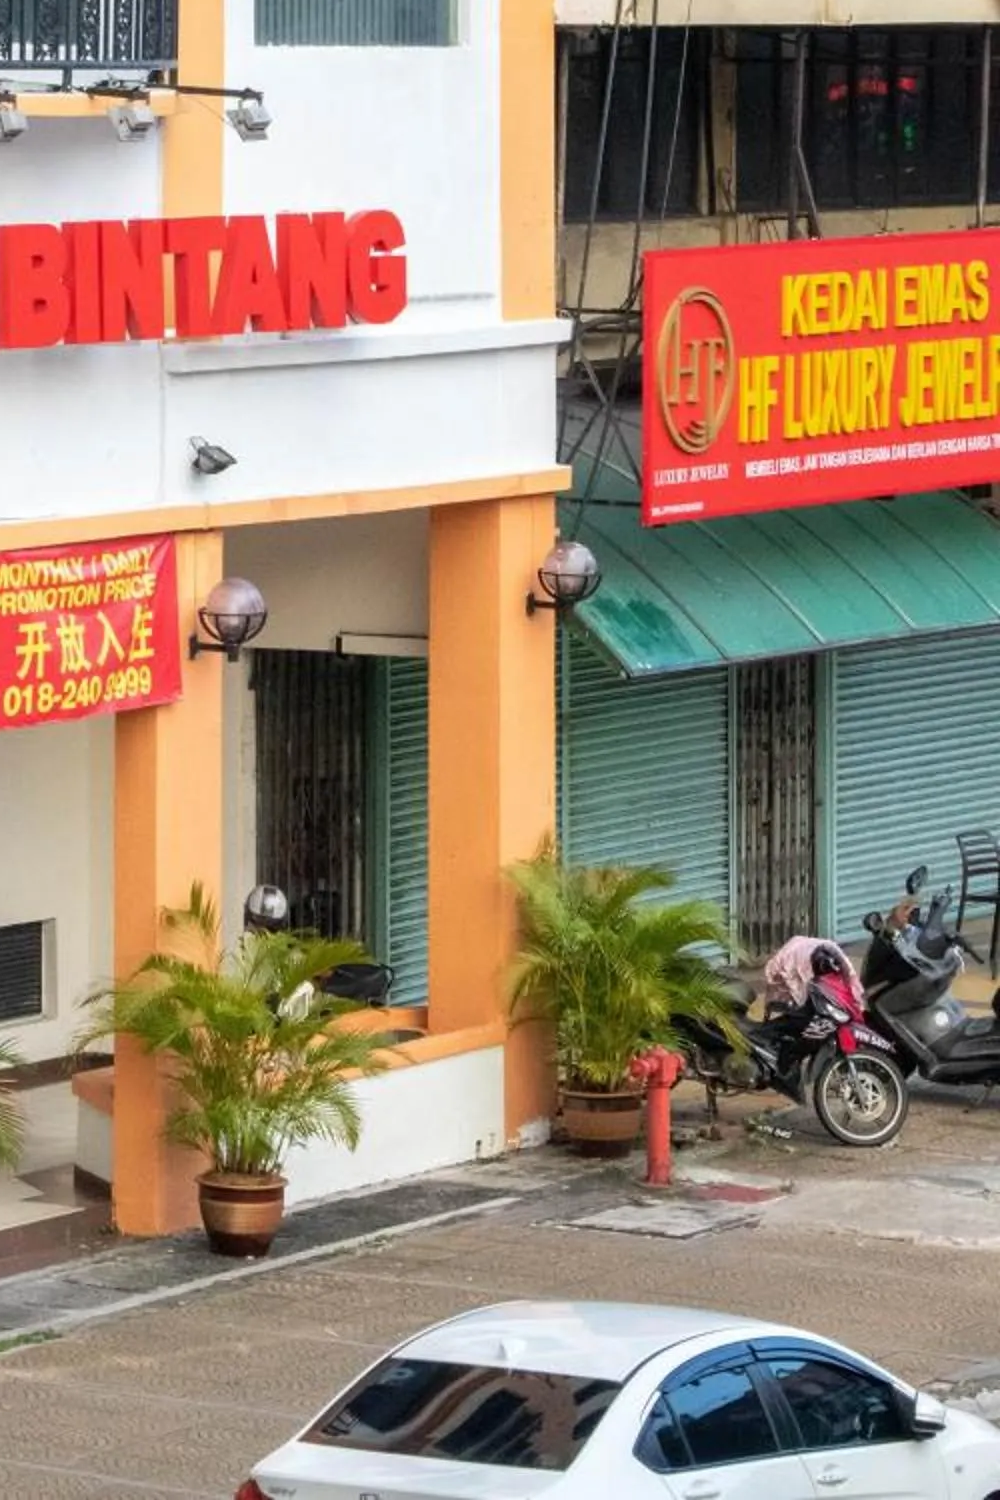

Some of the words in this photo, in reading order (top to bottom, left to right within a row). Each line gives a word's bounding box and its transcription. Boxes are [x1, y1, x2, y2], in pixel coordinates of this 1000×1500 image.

[781, 268, 887, 337] KEDAI
[895, 260, 990, 328] EMAS
[738, 355, 780, 443] HF
[784, 345, 896, 440] LUXURY
[104, 572, 157, 604] PRICE
[3, 675, 102, 718] 018-240
[103, 664, 152, 703] 9999
